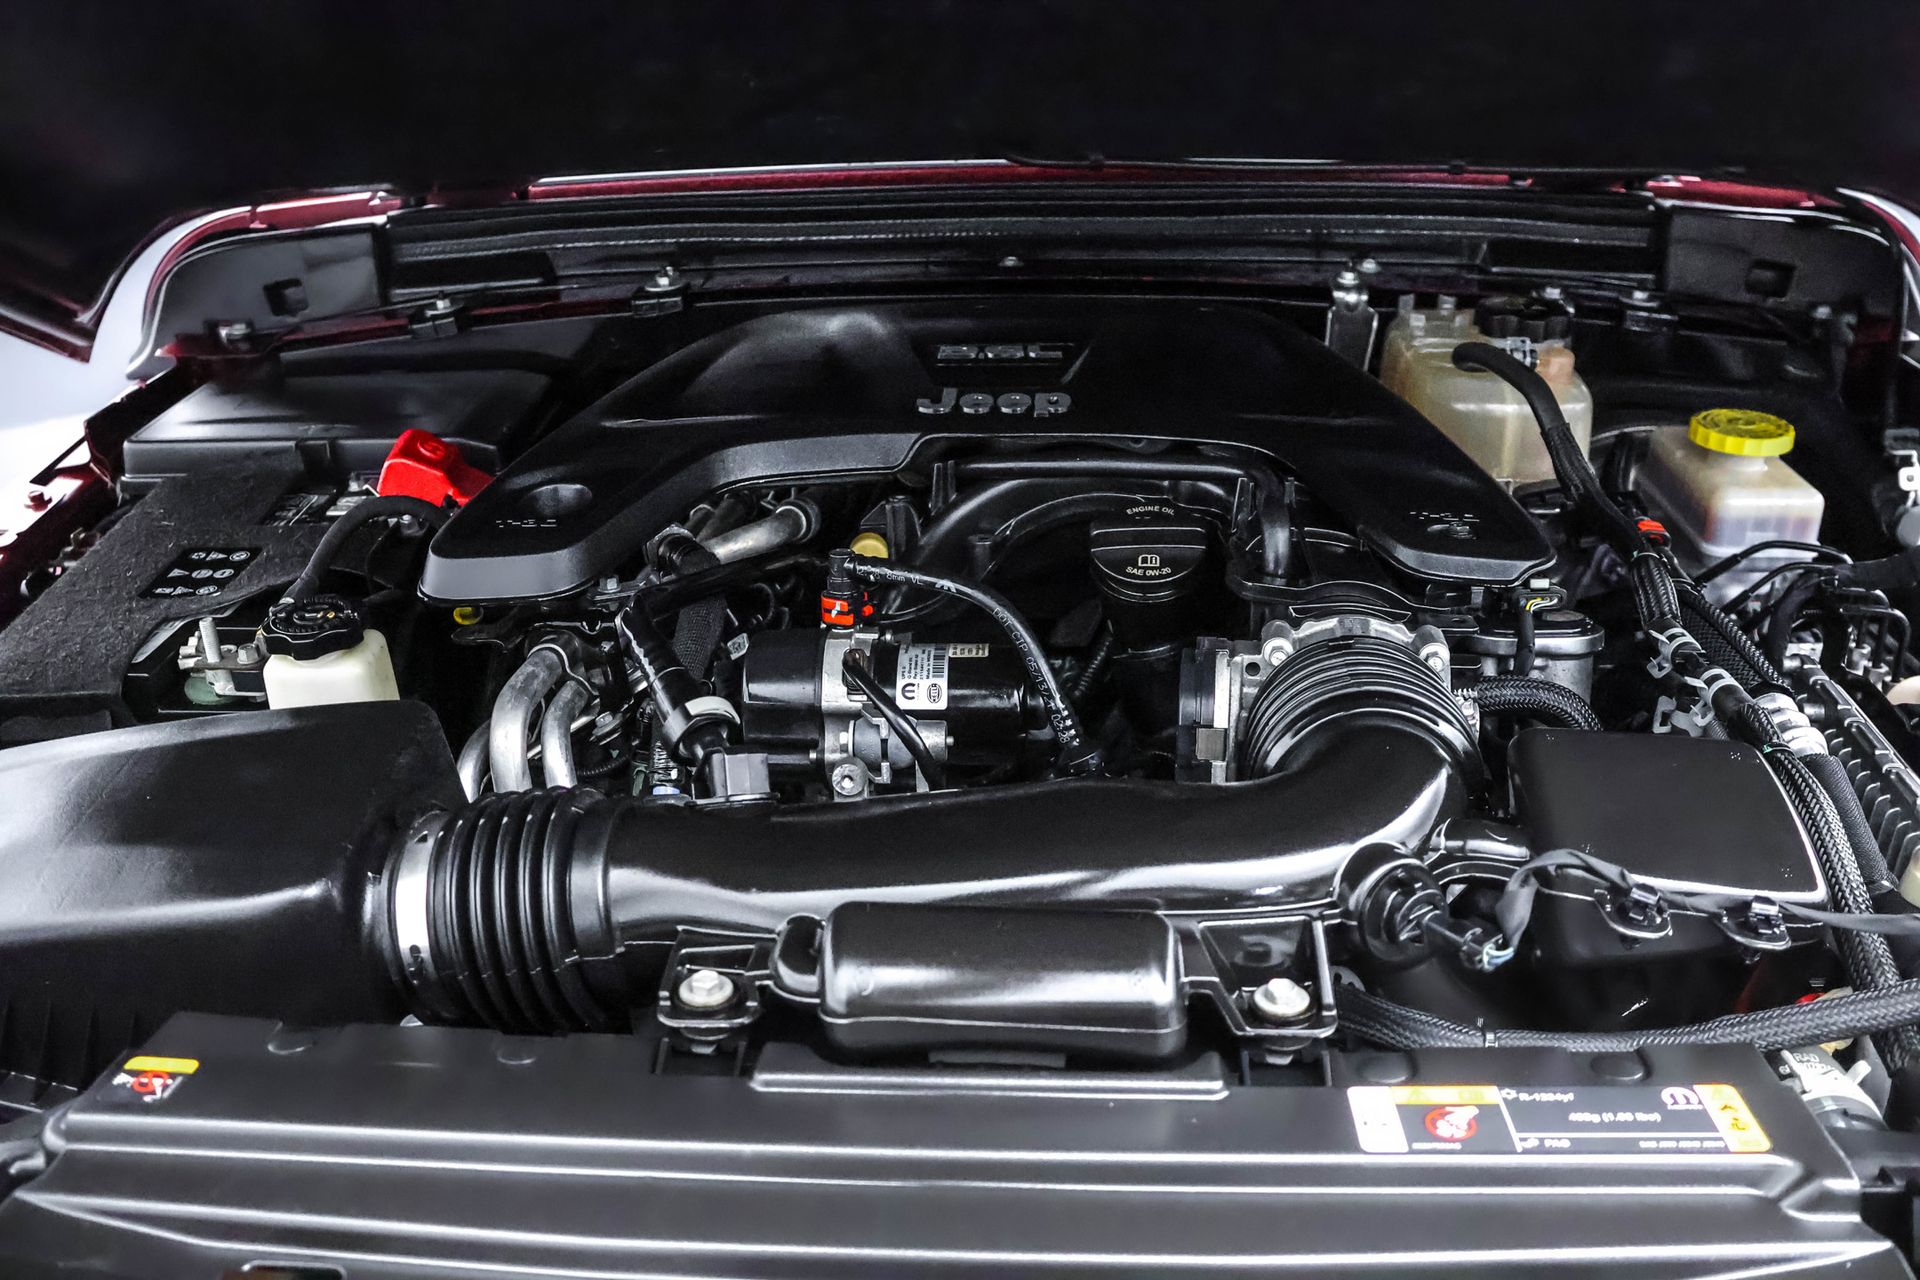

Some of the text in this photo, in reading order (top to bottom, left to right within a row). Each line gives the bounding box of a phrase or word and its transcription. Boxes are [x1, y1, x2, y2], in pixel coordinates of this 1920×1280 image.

[916, 387, 1072, 418] Jeep
[1126, 505, 1175, 516] ENGINE OIL
[1126, 566, 1172, 576] SAE 0W-20
[992, 607, 1013, 629] DOT
